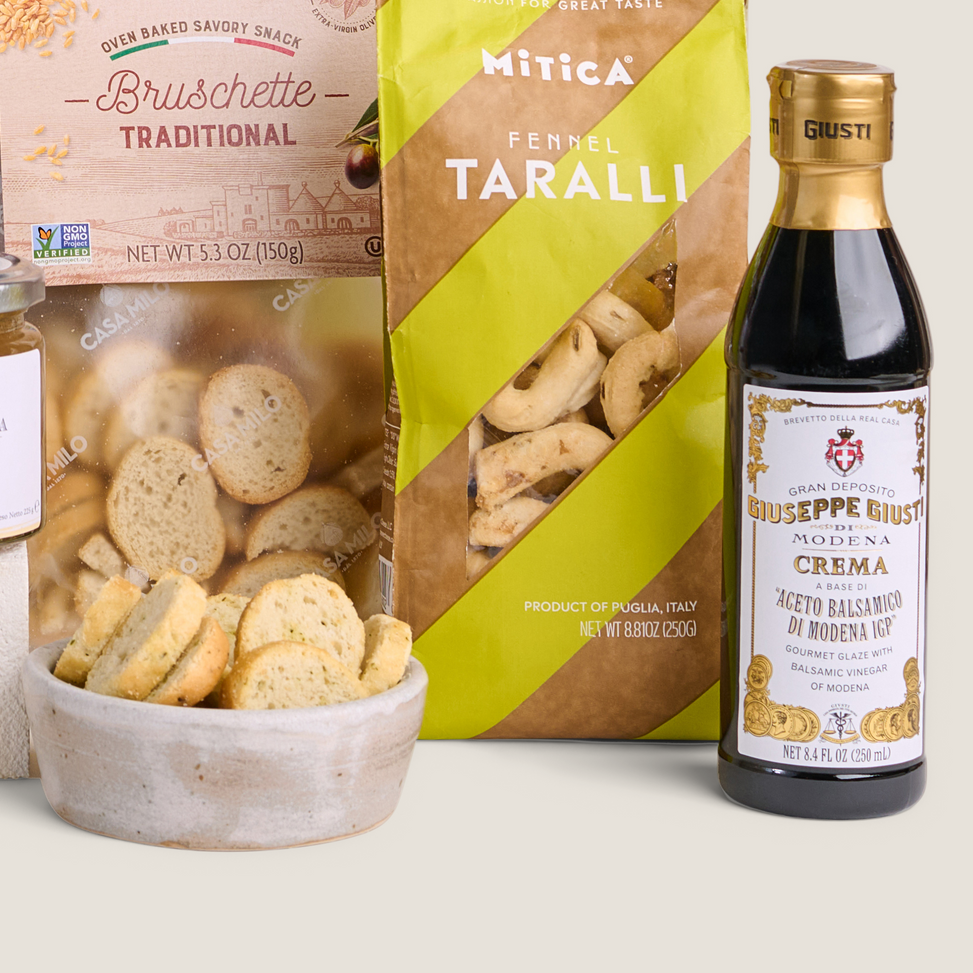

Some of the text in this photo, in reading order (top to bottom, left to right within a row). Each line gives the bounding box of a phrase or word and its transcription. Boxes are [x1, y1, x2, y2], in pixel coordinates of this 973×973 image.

[521, 0, 550, 9] FOR
[558, 0, 607, 10] GREAT
[100, 20, 302, 55] OVEN BAKED SAVORY SNACK
[96, 70, 316, 114] Bruschette
[120, 123, 297, 149] TRADITIONAL
[804, 120, 871, 140] GIUSTI
[509, 131, 619, 154] FENNEL
[446, 158, 687, 203] TARALLI
[36, 249, 88, 257] VERIFIED
[127, 241, 303, 265] NET WT 5.3 OZ (150g)
[784, 415, 827, 425] BREVETTO
[882, 417, 900, 426] CASA
[789, 483, 895, 498] GRAN DEPOSITO
[748, 495, 923, 525] GIUSEPPE GIUSTI
[792, 534, 890, 545] MODENA
[793, 555, 889, 575] CREMA
[524, 601, 697, 614] PRODUCT OF PUGLIA, ITALY
[785, 645, 893, 661] GOURMET GLAZE WITH
[791, 663, 888, 677] BALSAMIC VINEGAR
[811, 683, 870, 692] OF MODENA
[783, 745, 891, 763] NET 8.4 FL OZ (250 mL)
